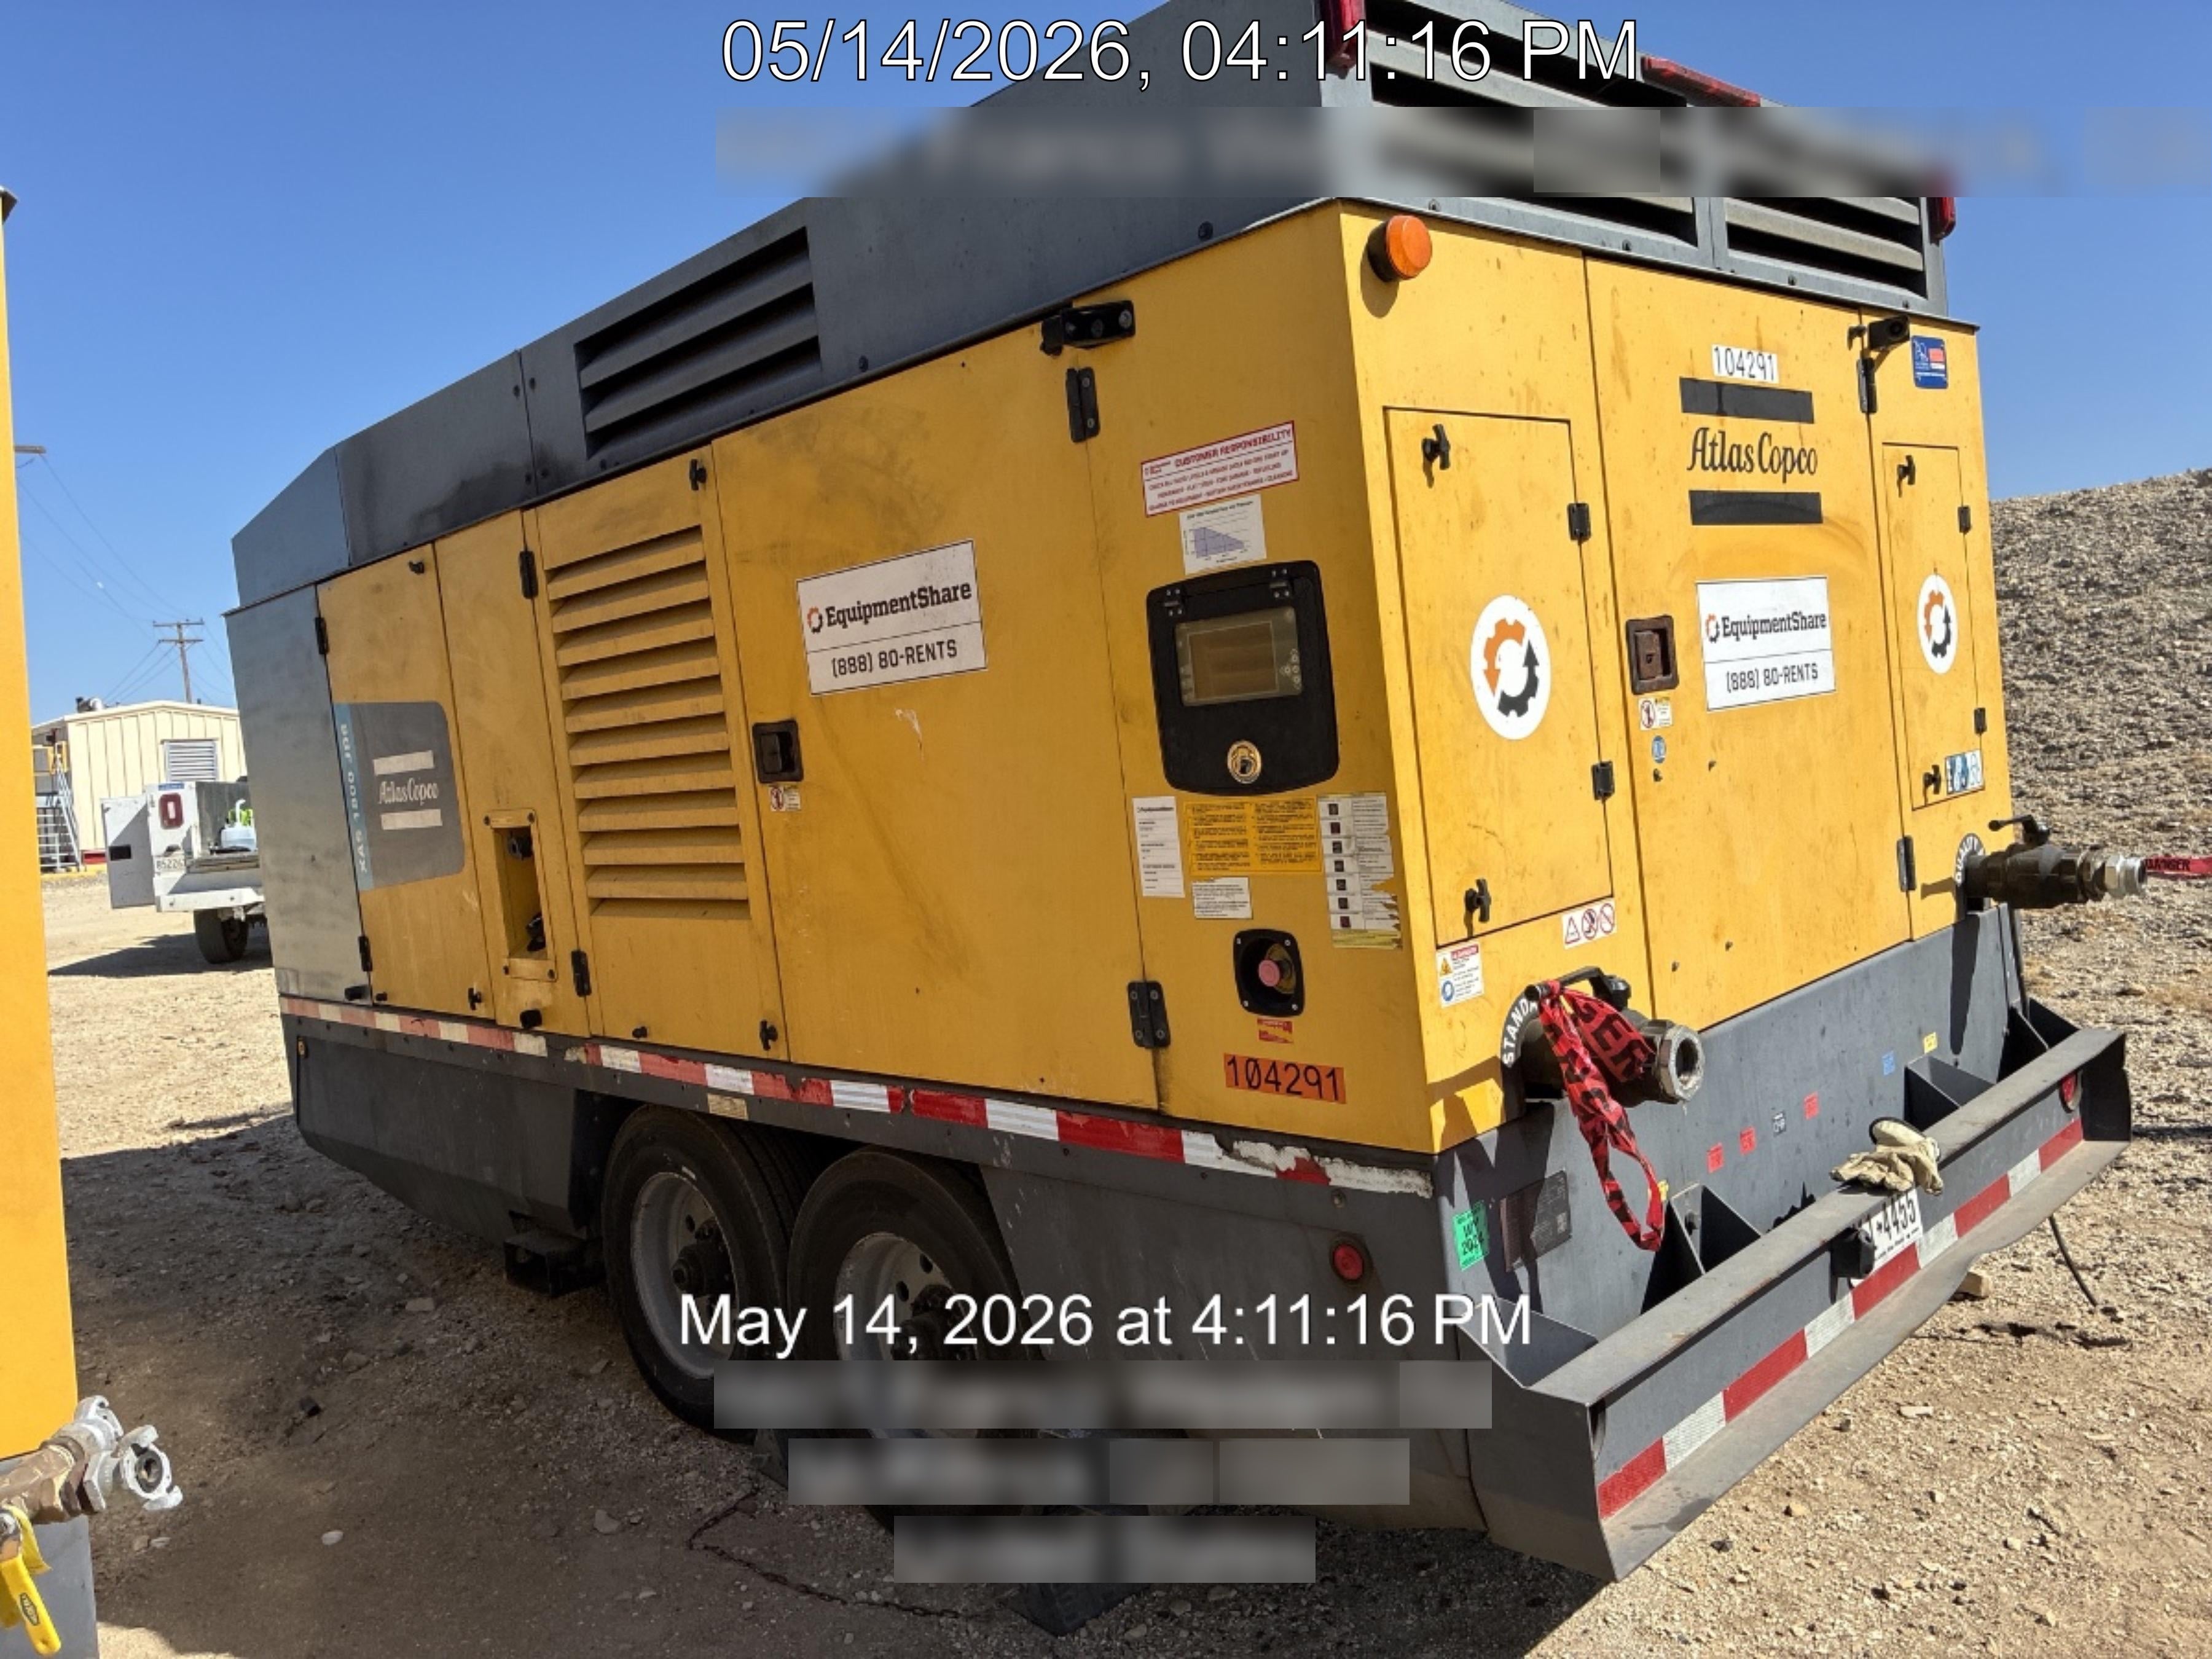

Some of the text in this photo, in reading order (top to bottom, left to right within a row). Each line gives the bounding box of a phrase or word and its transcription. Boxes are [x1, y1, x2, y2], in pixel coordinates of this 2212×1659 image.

[1714, 346, 1775, 381] 104291
[825, 582, 972, 629] EquipmentShare
[1722, 610, 1827, 641] EquipmentShare
[831, 639, 958, 678] (888) 80-RENTS
[1727, 662, 1818, 693] (888) 80-RENTS
[1228, 1055, 1339, 1101] 104291
